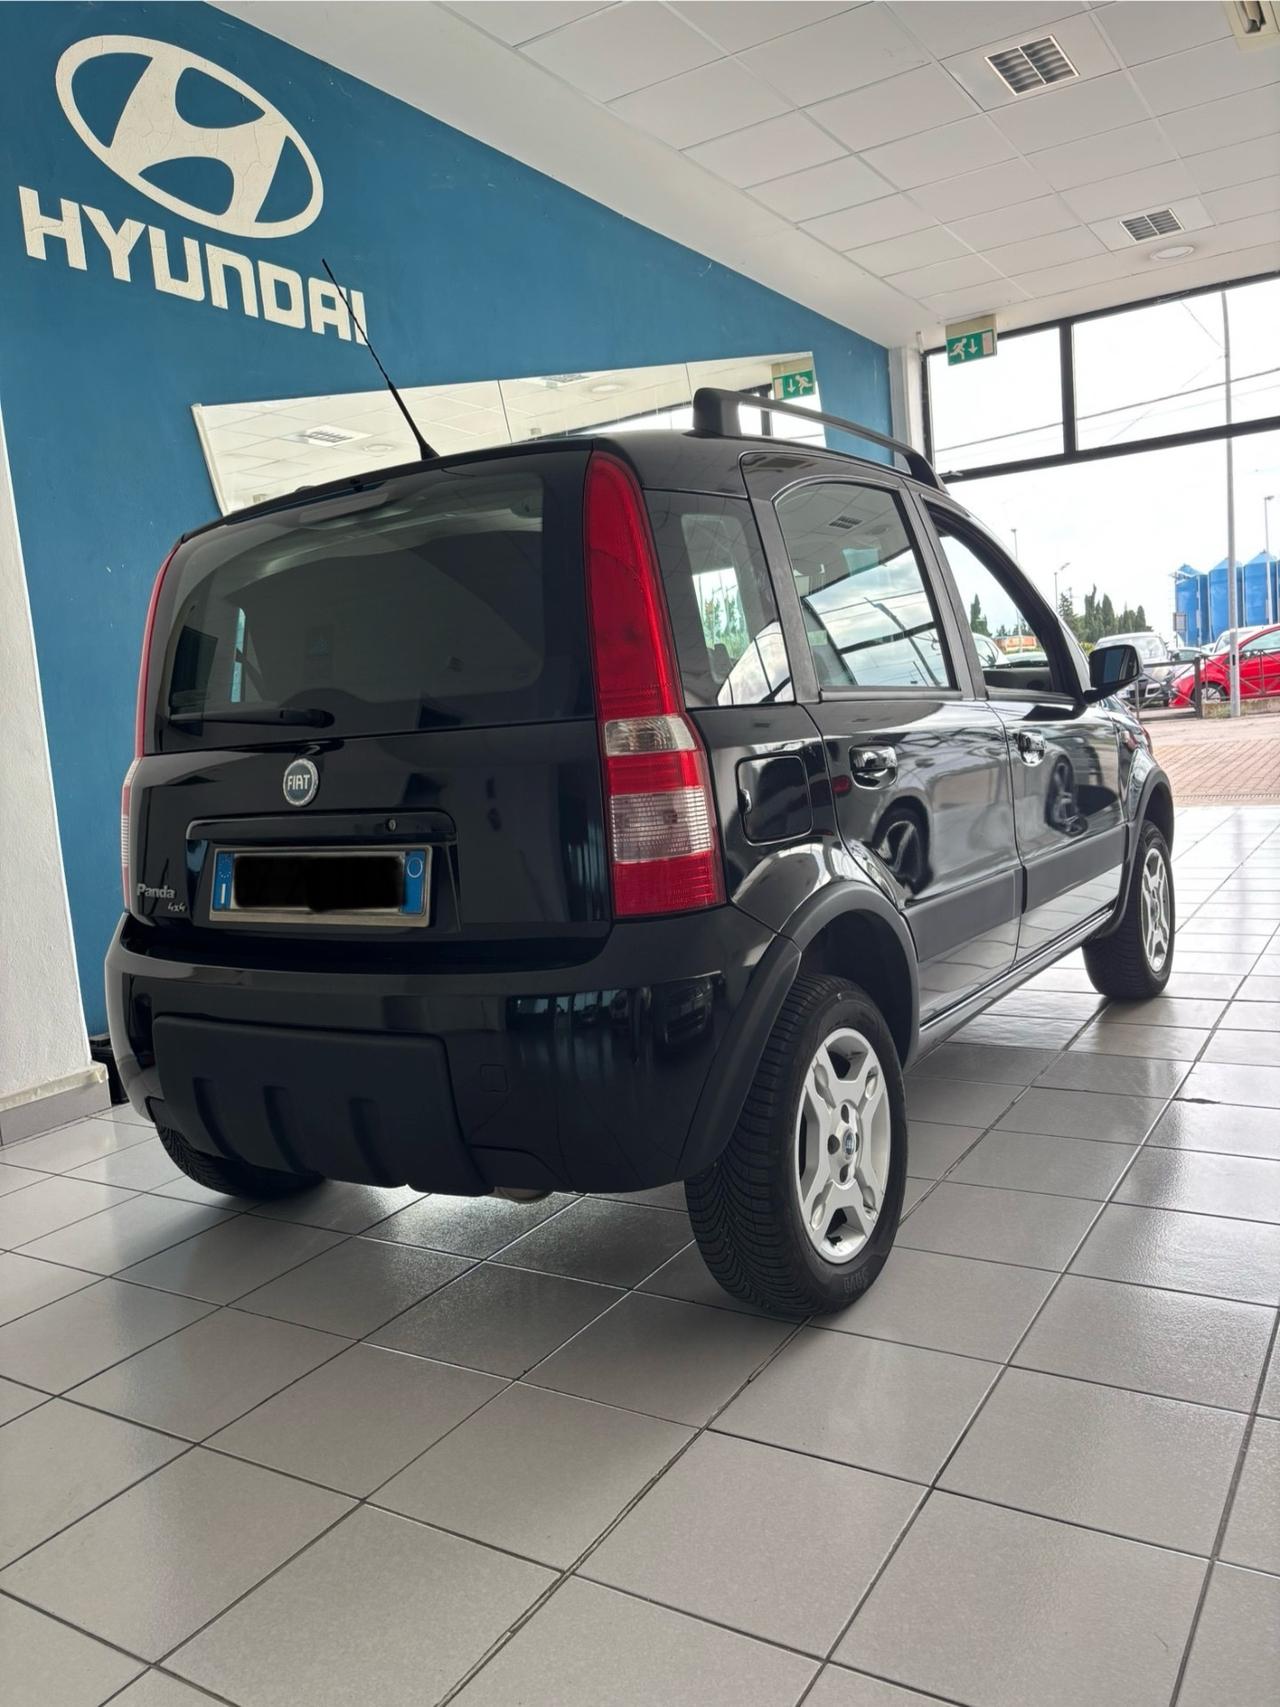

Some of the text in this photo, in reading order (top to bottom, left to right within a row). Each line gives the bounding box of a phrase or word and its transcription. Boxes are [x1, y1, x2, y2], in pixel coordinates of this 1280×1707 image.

[18, 185, 368, 346] HYUNDAI
[287, 774, 311, 790] FIAT
[136, 883, 176, 899] Panda
[167, 902, 186, 912] 4x4
